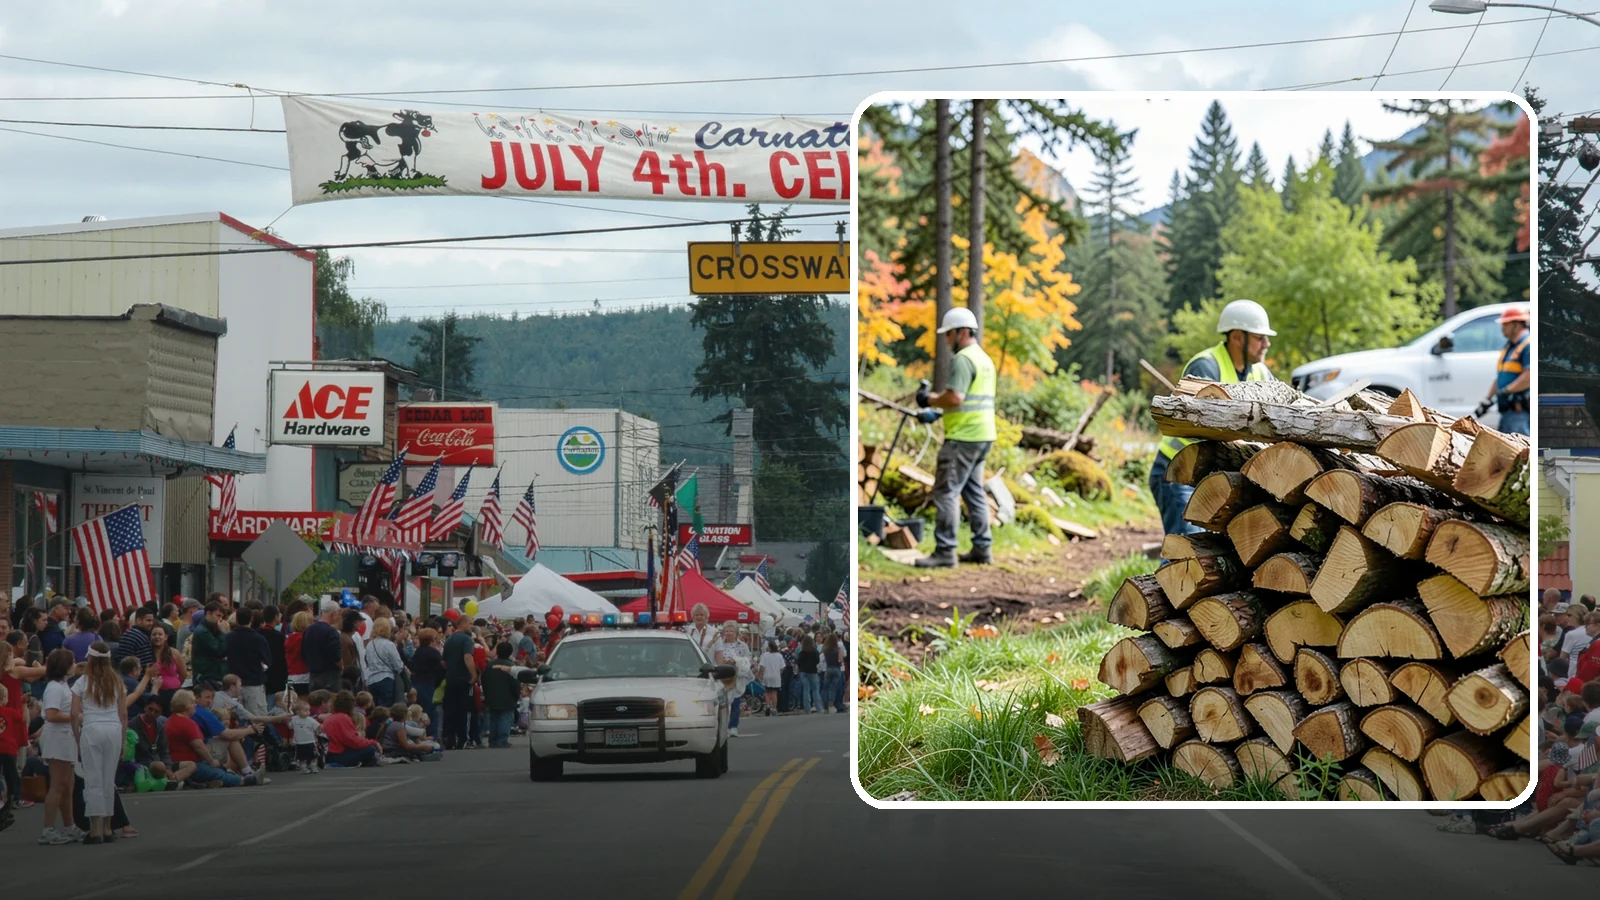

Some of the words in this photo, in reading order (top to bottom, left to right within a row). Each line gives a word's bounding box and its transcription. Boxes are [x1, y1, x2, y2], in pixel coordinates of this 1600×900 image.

[481, 141, 605, 193] JULY
[632, 150, 746, 198] 4th.
[696, 254, 851, 280] CROSSWA
[282, 380, 374, 420] ACE
[405, 409, 453, 422] CEDAR
[461, 409, 485, 422] LOG
[283, 421, 371, 437] Hardware
[96, 485, 124, 495] Vincent
[126, 486, 136, 495] de
[137, 486, 155, 495] Paul
[81, 503, 154, 522] THT
[212, 516, 331, 536] HARDARE
[688, 526, 741, 535] CRNATION
[699, 535, 730, 544] GLASS
